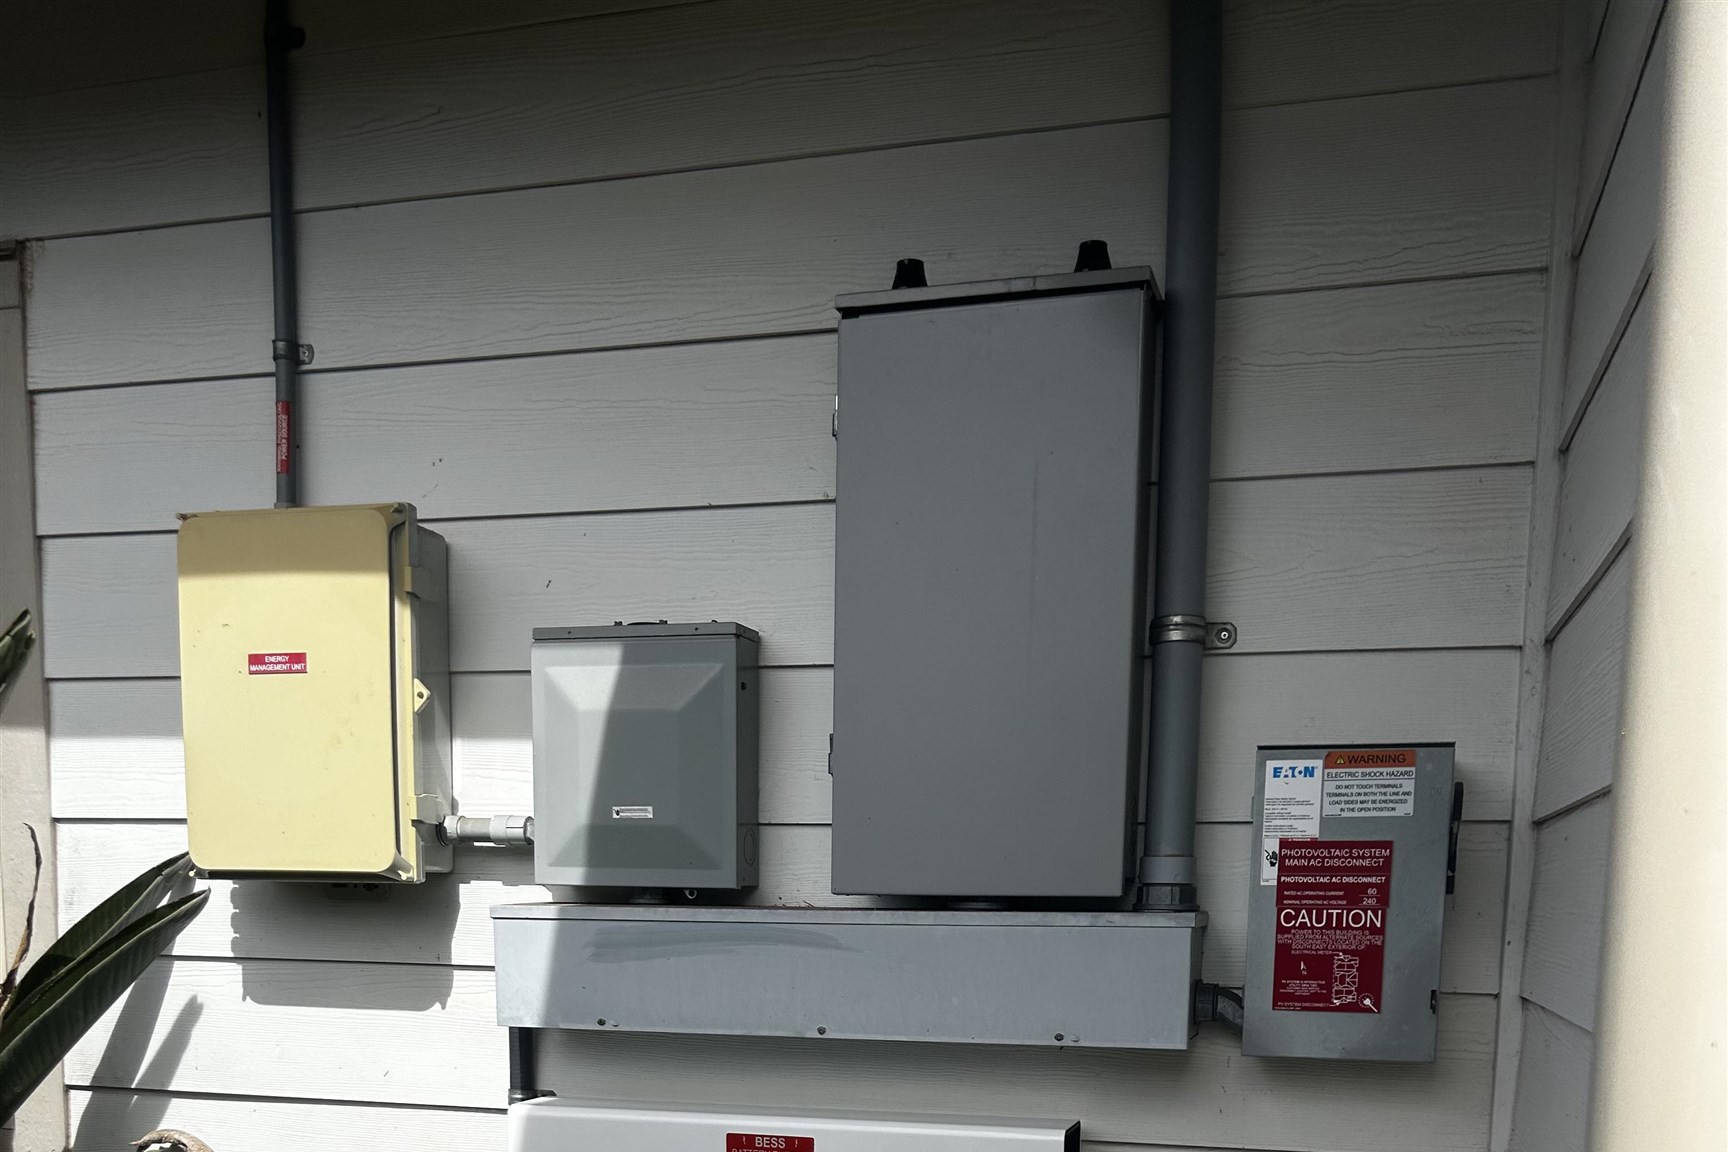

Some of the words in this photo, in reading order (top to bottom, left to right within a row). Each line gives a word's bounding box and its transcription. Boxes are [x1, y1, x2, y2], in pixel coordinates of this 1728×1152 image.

[264, 655, 289, 663] ENERGY
[1348, 753, 1406, 764] WARNING
[1281, 848, 1350, 857] PHOTOVOLTAIC
[1351, 849, 1390, 857] SYSTEM
[1324, 858, 1384, 867] DISCONNECT
[1367, 887, 1377, 895] 60
[1362, 897, 1377, 905] 240
[1280, 908, 1382, 928] CAUTION
[755, 1137, 786, 1149] BESS
